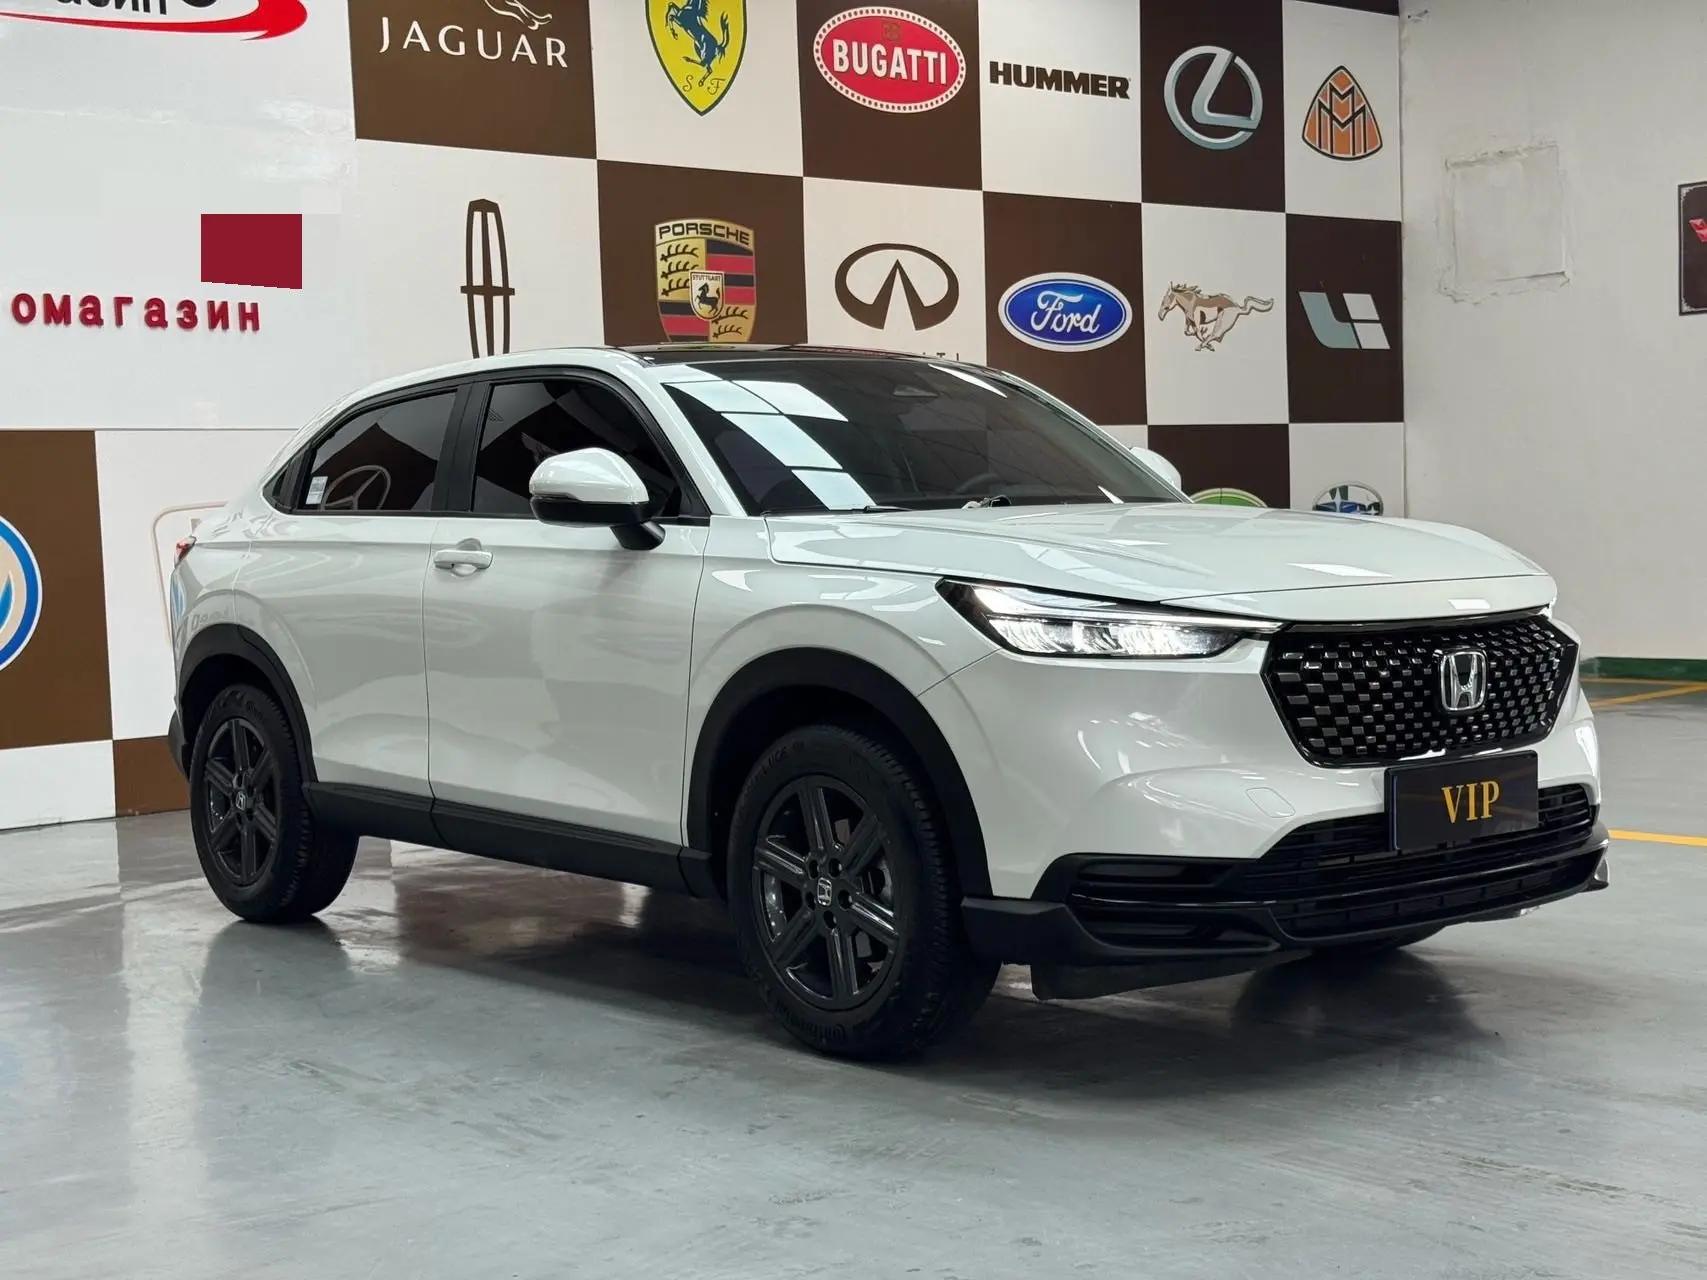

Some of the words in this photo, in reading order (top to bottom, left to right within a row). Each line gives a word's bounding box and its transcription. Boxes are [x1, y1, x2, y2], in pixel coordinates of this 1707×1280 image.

[379, 16, 568, 68] JAGUAR
[832, 39, 947, 84] BUGATTI
[682, 74, 694, 92] S
[989, 60, 1130, 99] HUMMER
[659, 223, 749, 245] PORSCHE
[11, 292, 261, 332] омагазин
[1031, 289, 1101, 335] Ford
[1441, 781, 1499, 823] VIP
